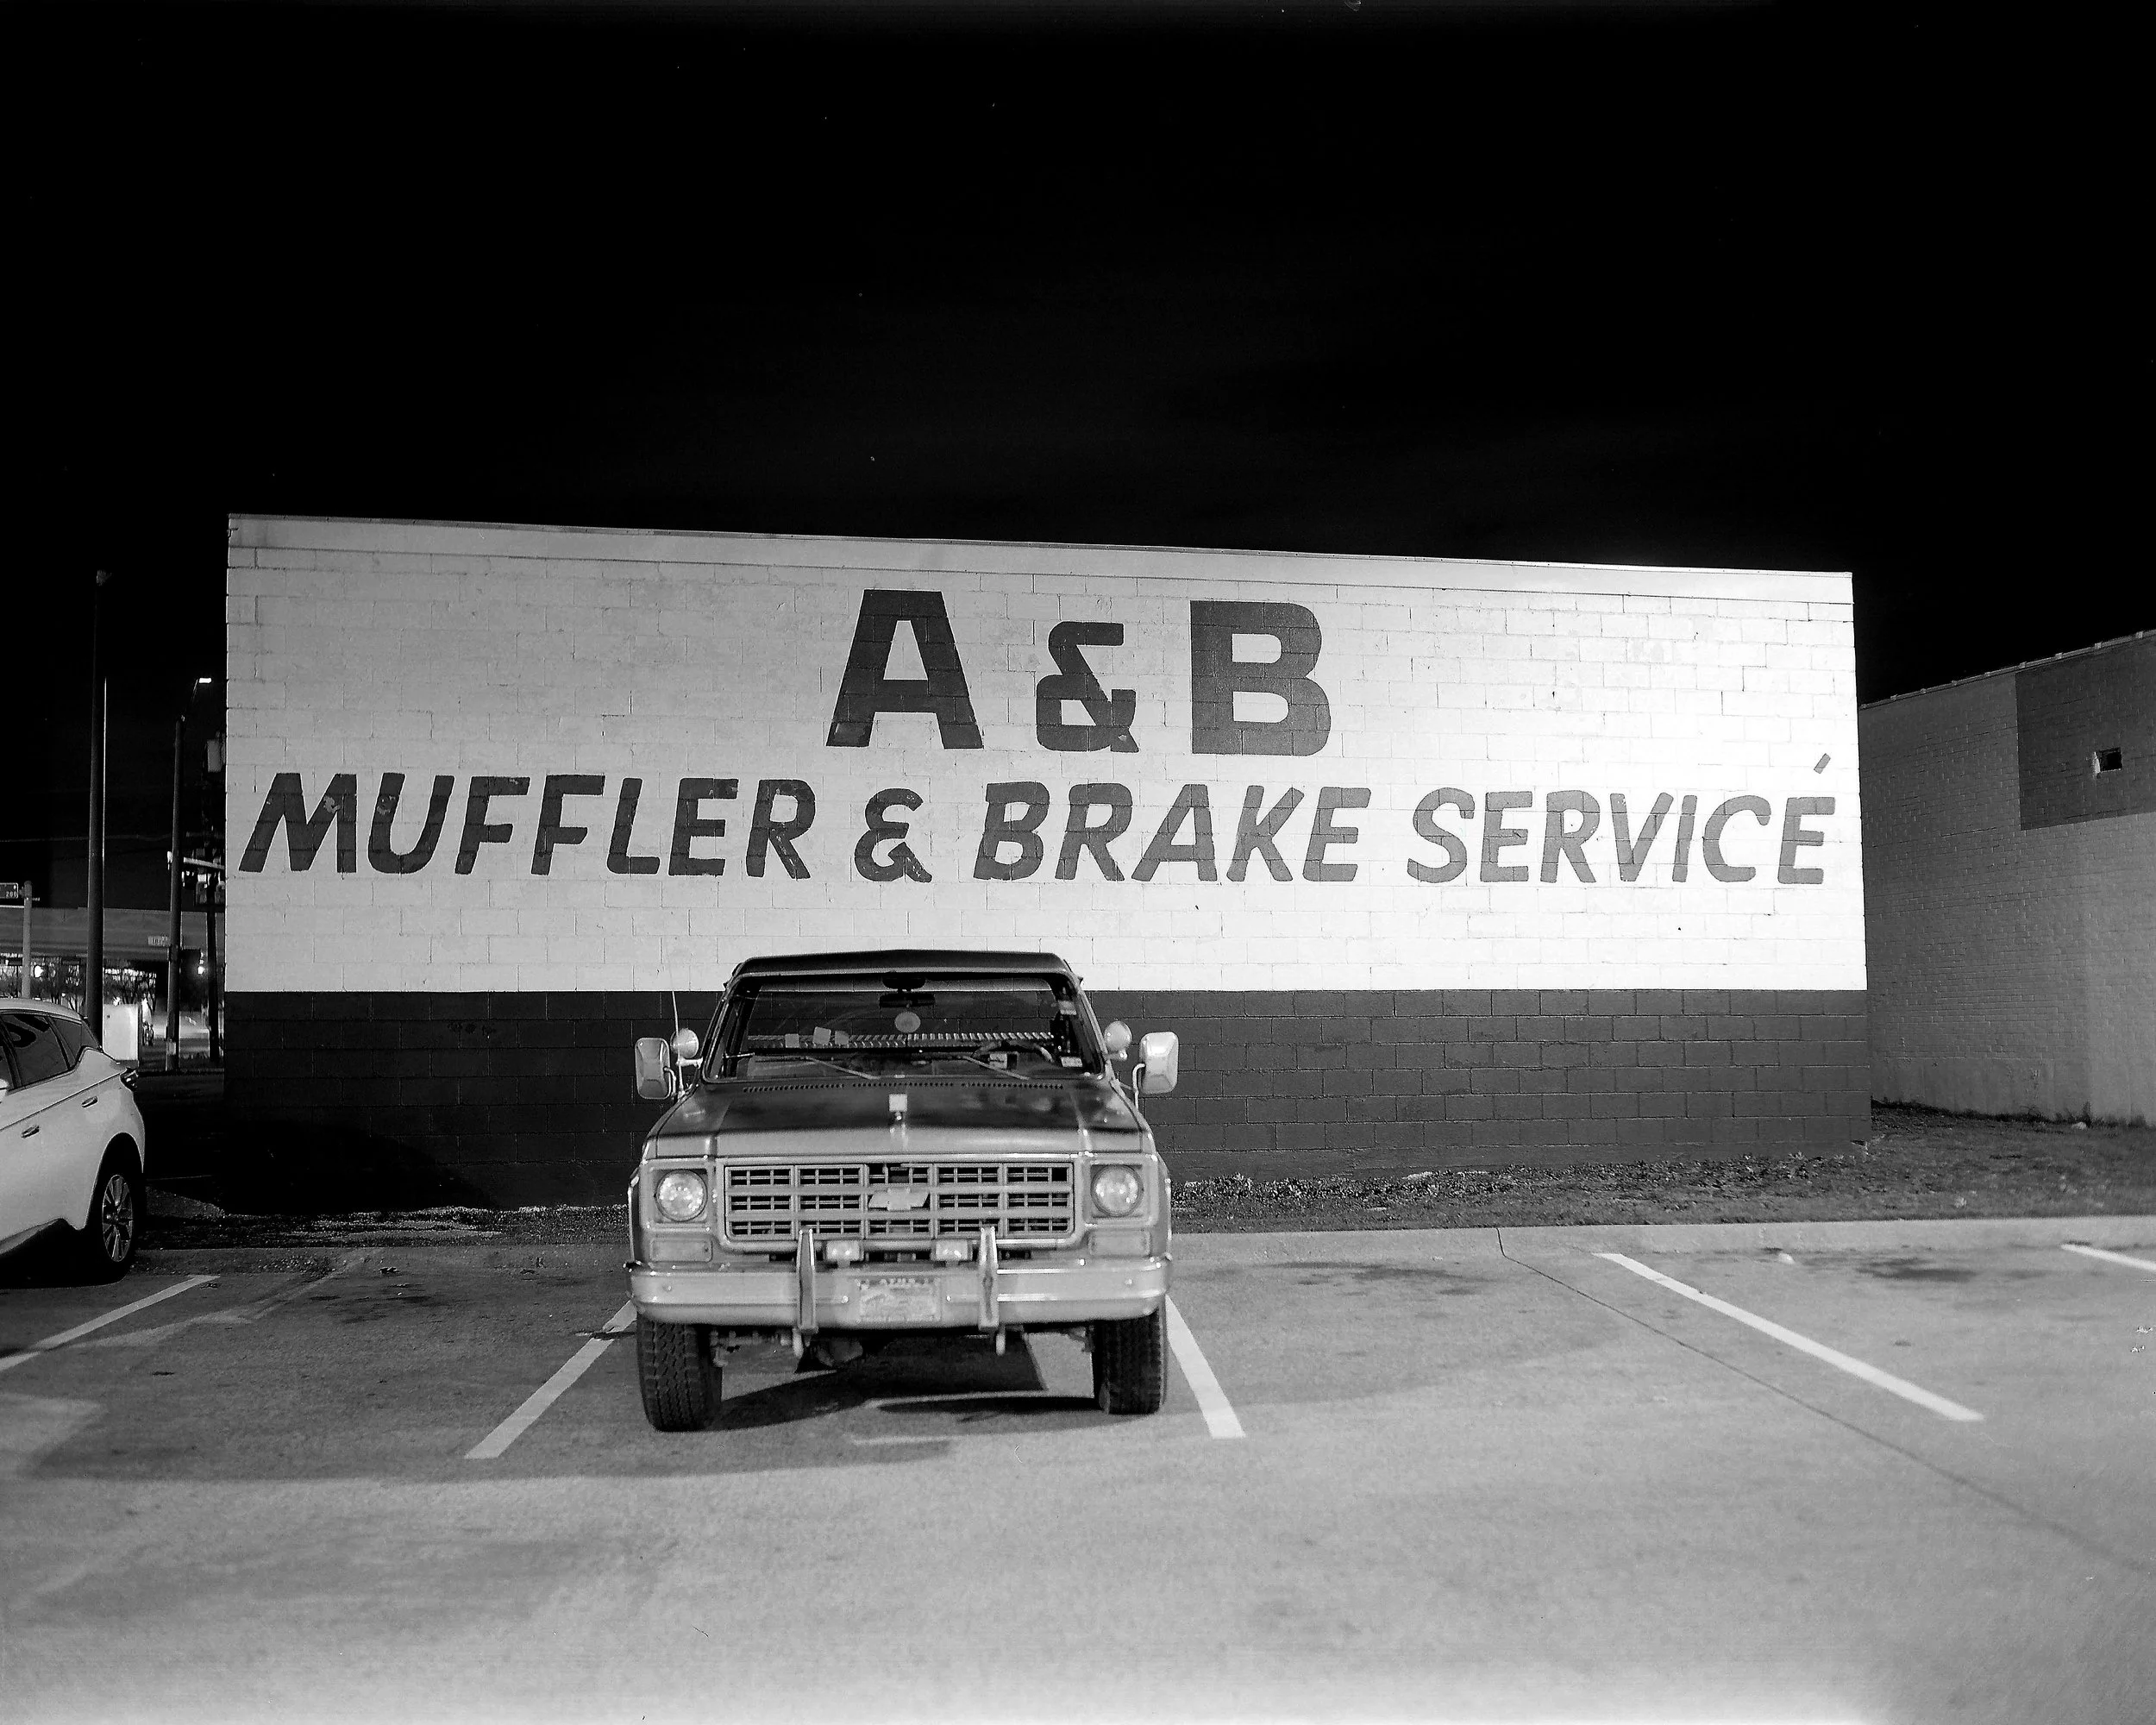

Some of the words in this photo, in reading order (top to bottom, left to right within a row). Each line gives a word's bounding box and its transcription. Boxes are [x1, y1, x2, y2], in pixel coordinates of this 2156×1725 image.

[827, 589, 984, 750] A
[1036, 621, 1138, 753] &
[1190, 600, 1332, 757] B
[239, 772, 817, 880] MUFFLER
[854, 787, 933, 882] &
[975, 781, 1372, 883] BRAKE
